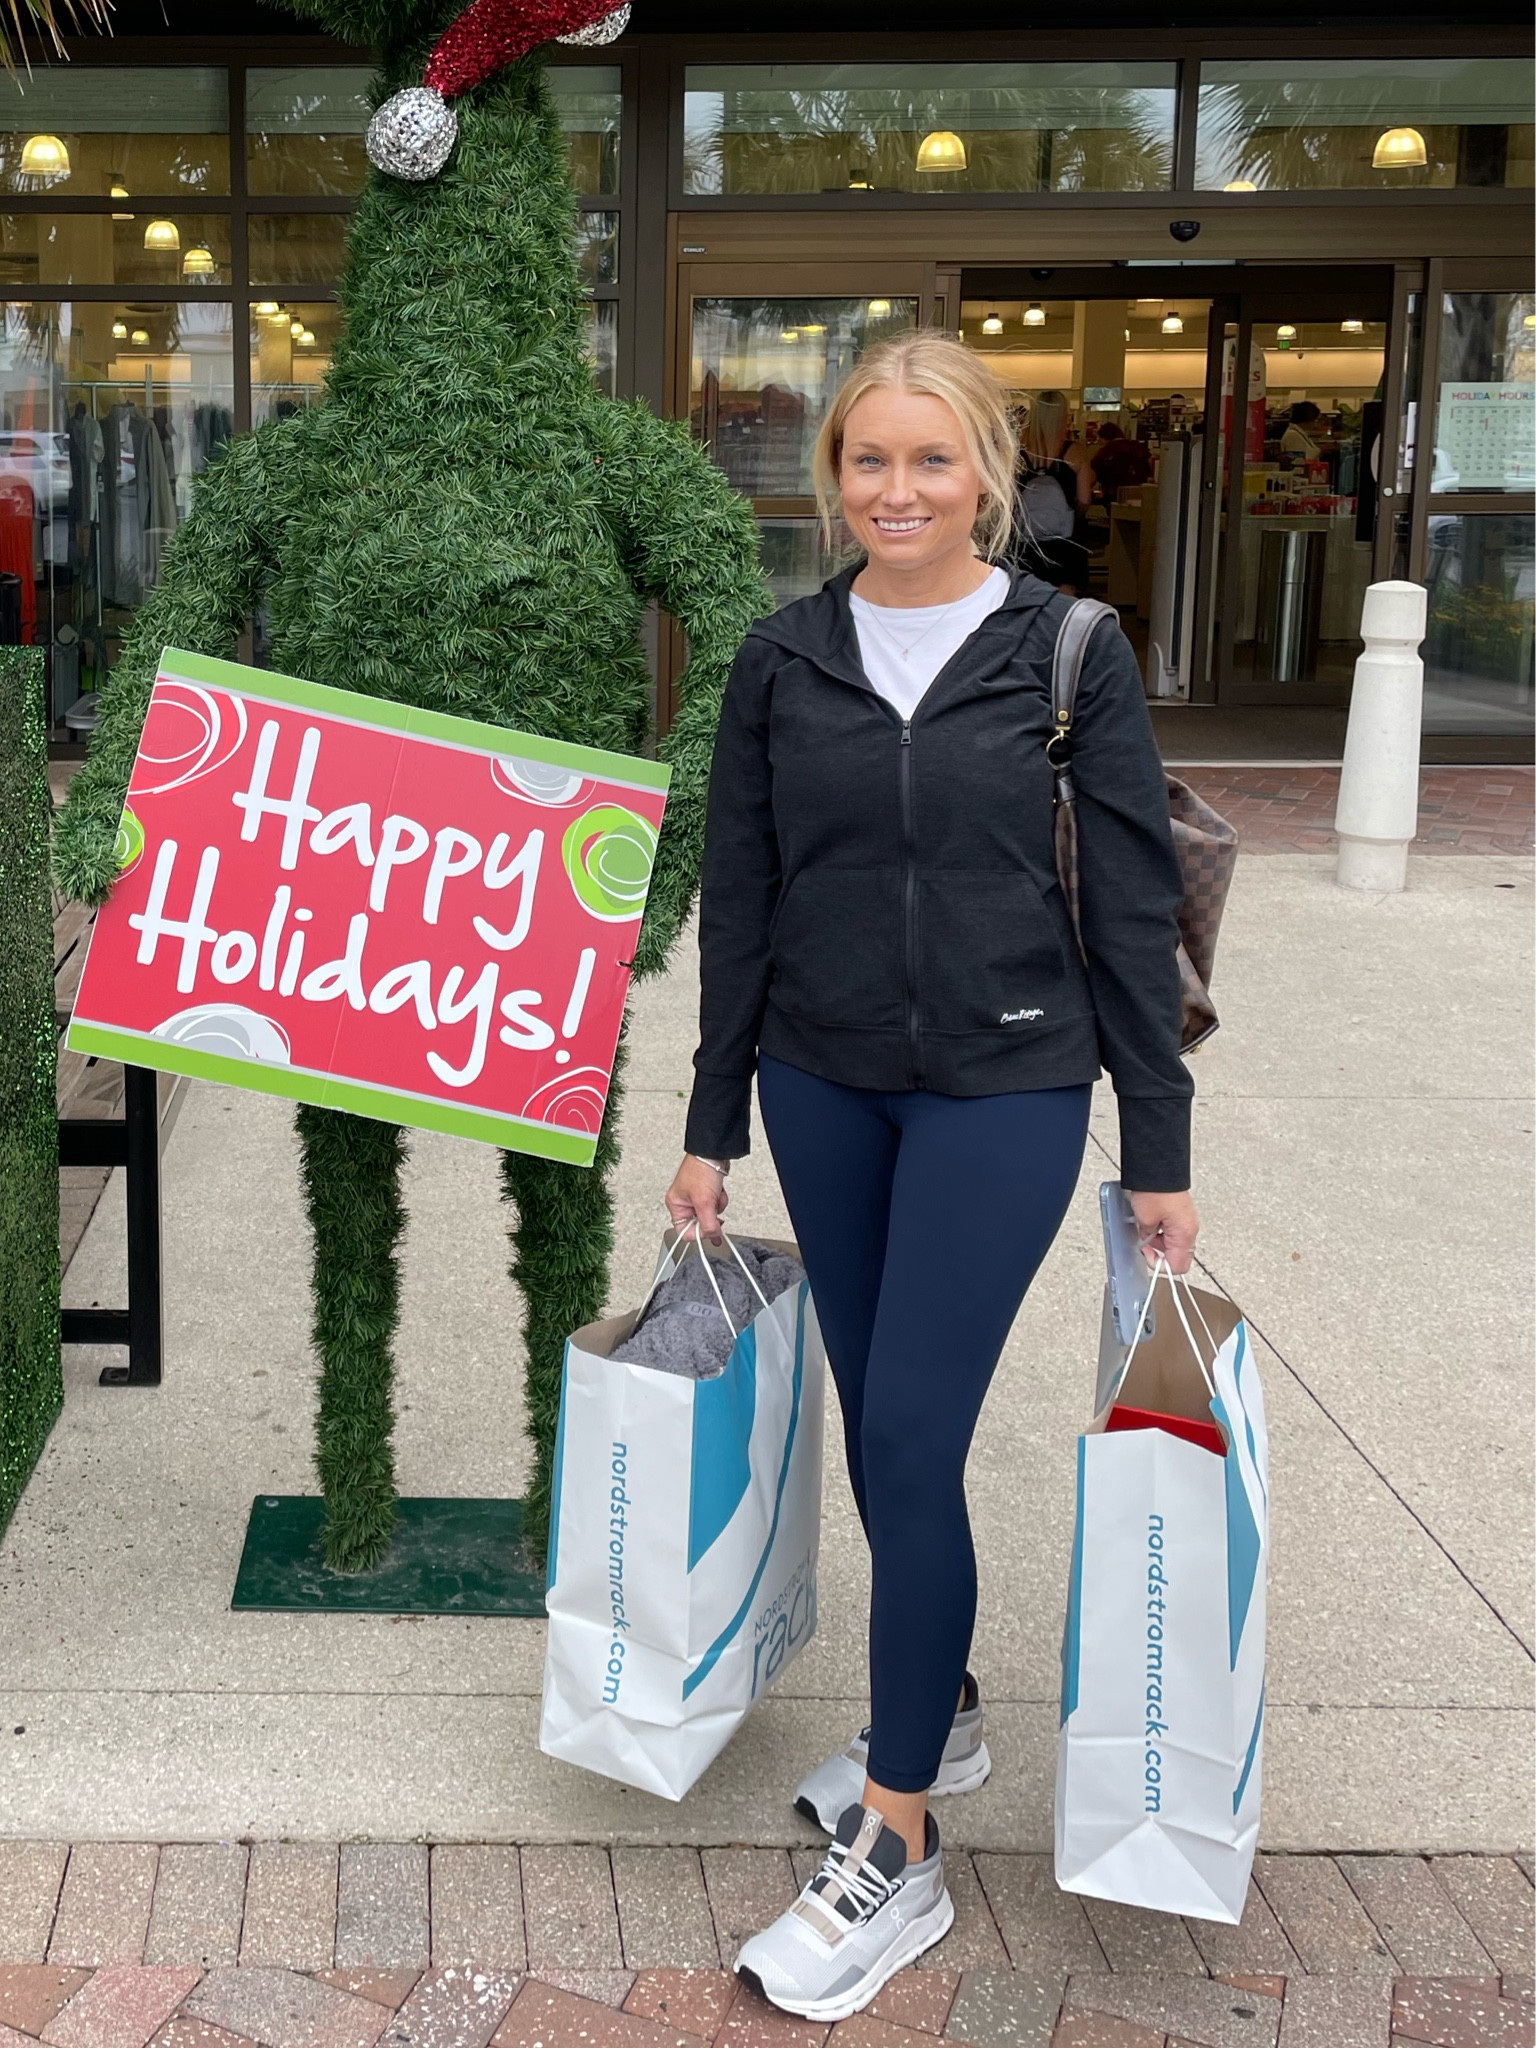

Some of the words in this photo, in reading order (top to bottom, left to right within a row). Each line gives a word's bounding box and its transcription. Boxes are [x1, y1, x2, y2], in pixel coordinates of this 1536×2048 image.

[1452, 392, 1497, 401] HOLIDAY
[1499, 392, 1536, 401] HOURS
[232, 719, 544, 951] Happy
[128, 838, 597, 1087] Holidays!
[602, 1441, 631, 1704] nordstromrack.com
[1145, 1513, 1166, 1814] nordstromrack.com
